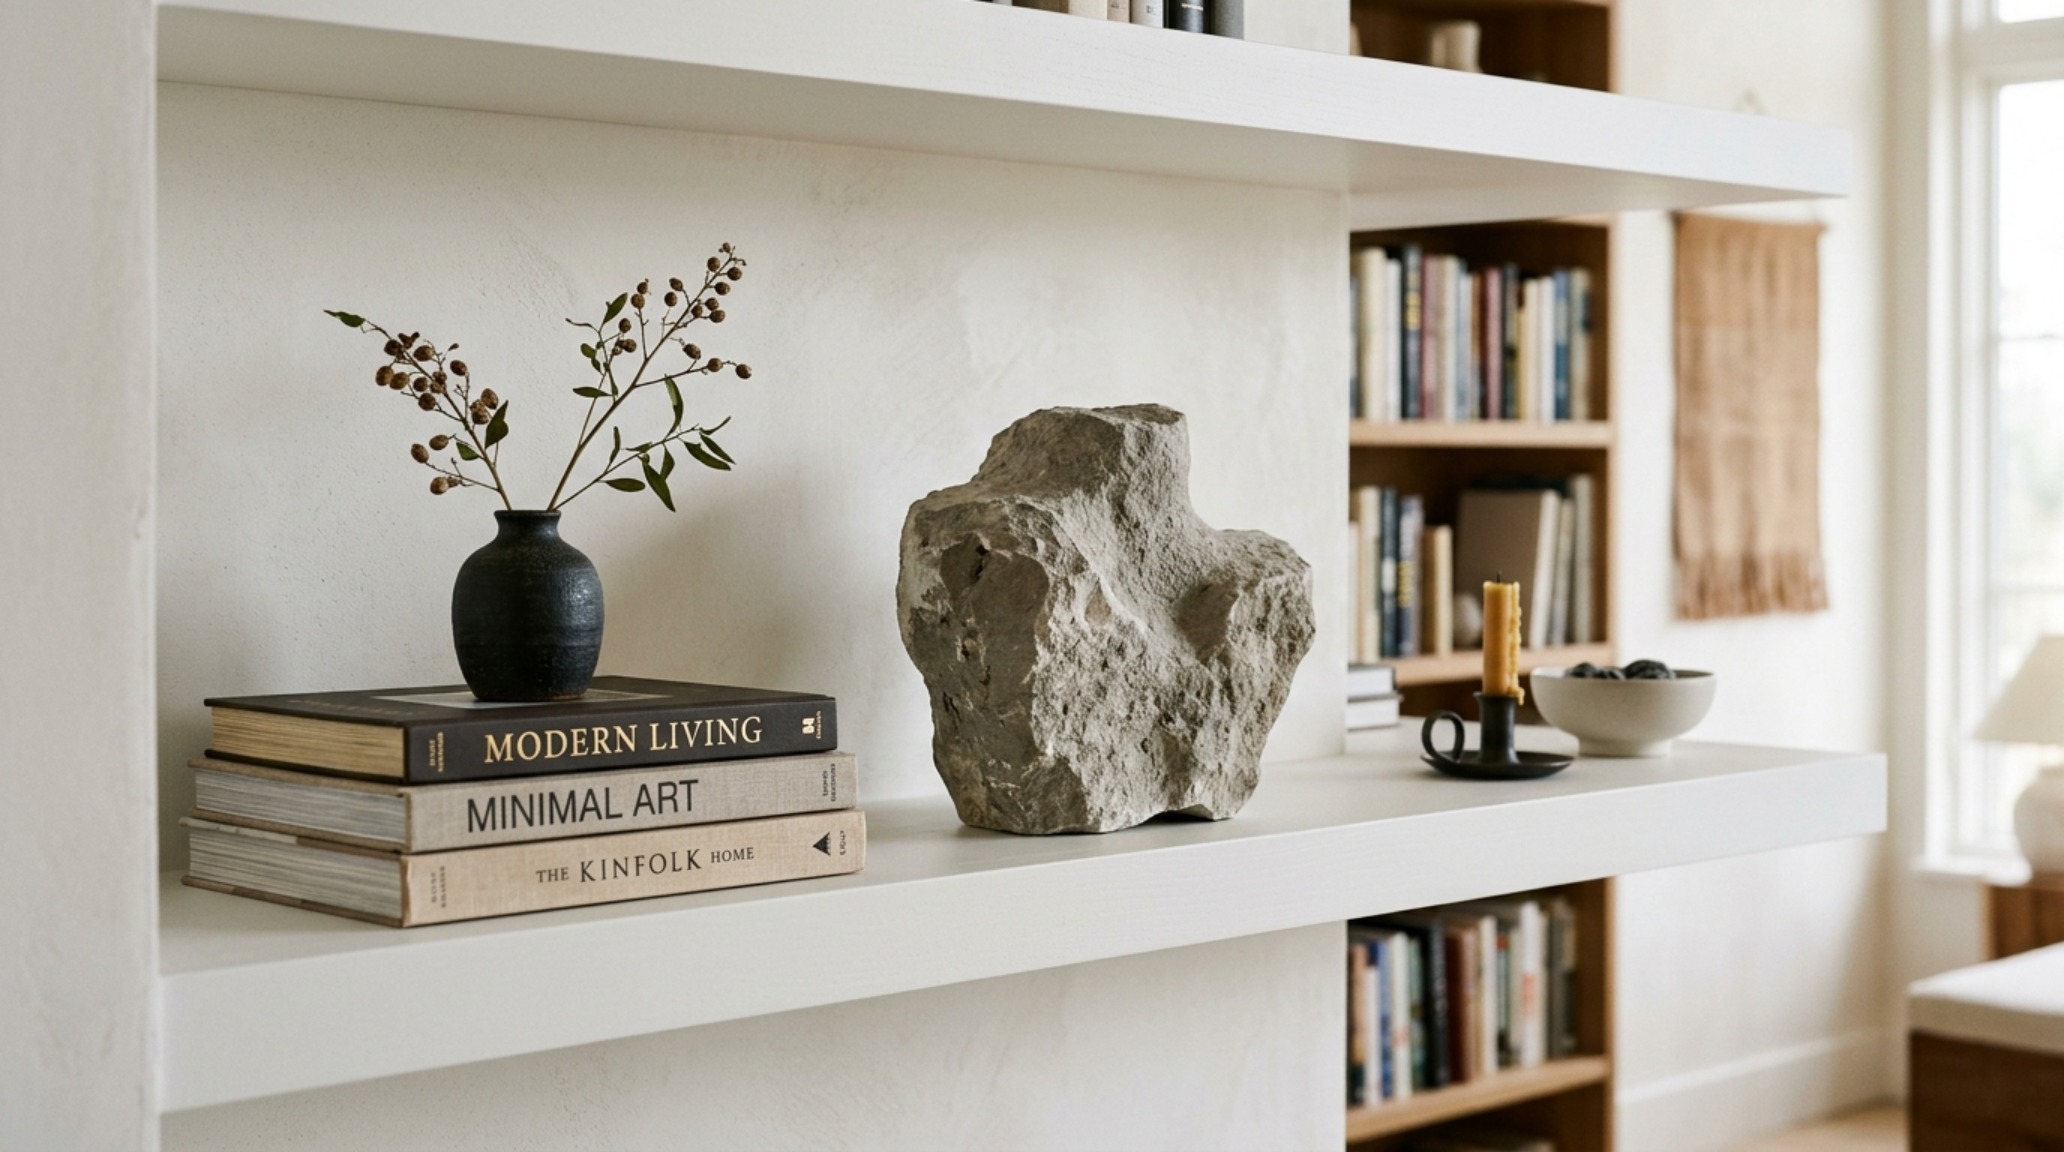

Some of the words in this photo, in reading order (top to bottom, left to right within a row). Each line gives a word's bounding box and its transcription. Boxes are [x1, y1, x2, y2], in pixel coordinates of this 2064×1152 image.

[484, 723, 638, 763] MODERN
[649, 716, 763, 751] LIVING
[467, 787, 623, 833] MINIMAL
[633, 779, 699, 817] ART
[536, 867, 569, 883] THE
[580, 849, 702, 883] KINFOLK
[711, 847, 755, 863] HOME
